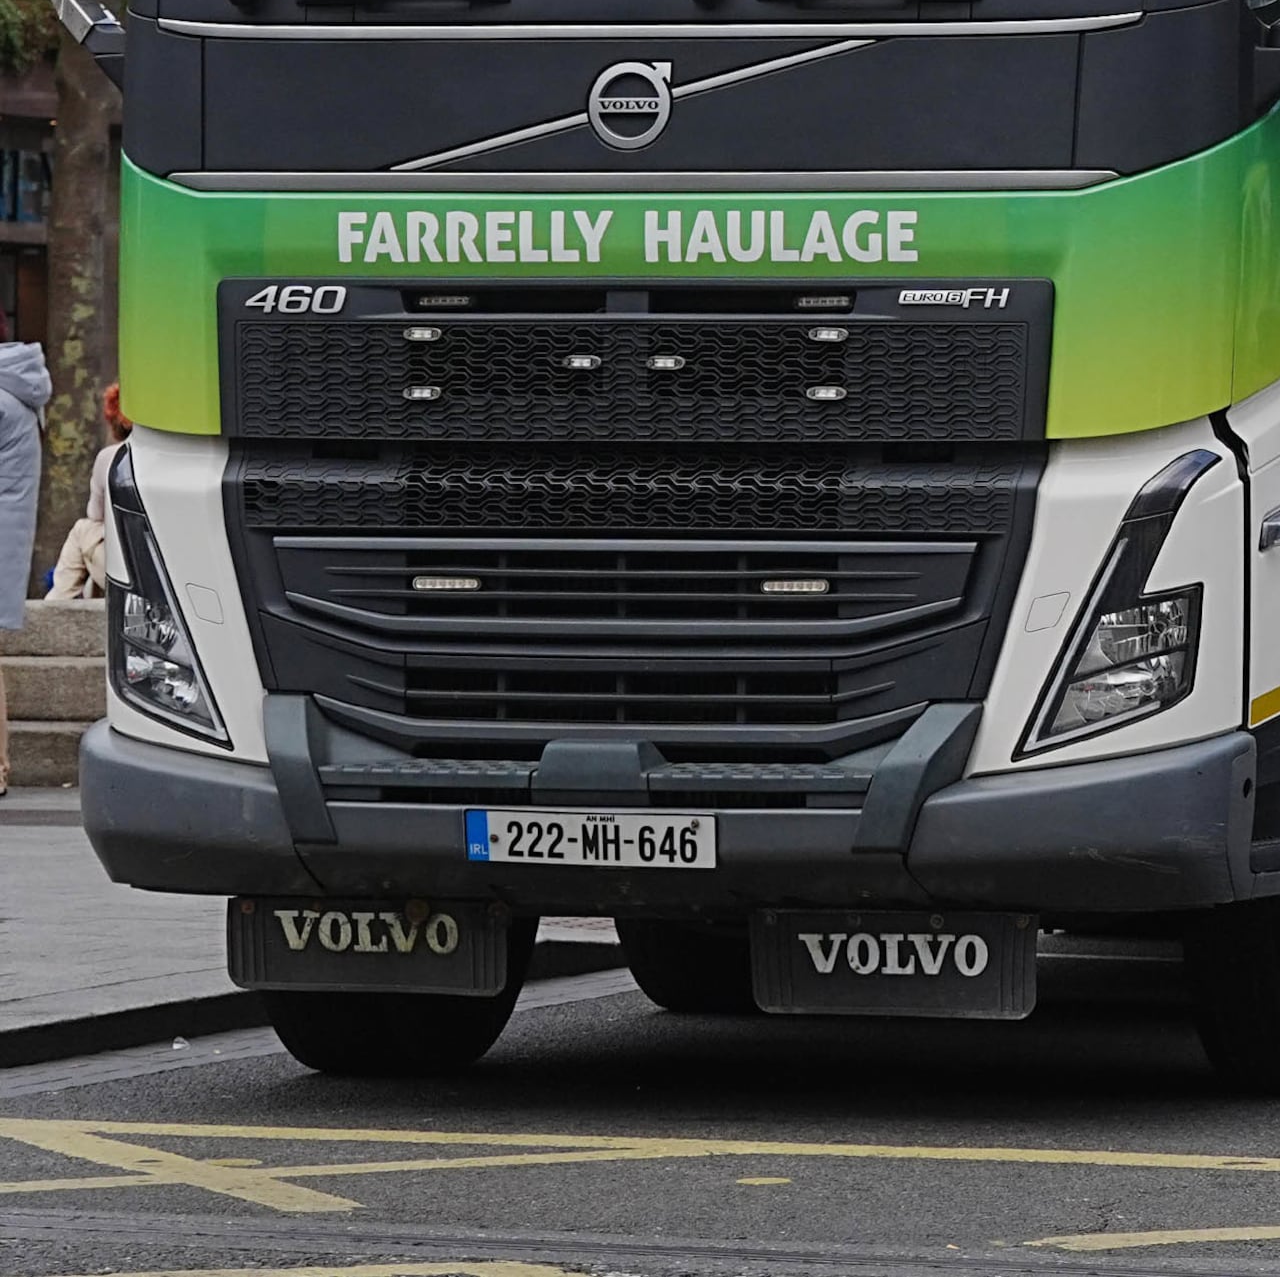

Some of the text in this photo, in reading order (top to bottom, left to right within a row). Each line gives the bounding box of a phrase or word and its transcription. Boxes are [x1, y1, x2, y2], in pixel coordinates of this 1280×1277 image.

[599, 100, 659, 110] VOLVO
[336, 210, 918, 264] FARRELLY HAULAGE
[244, 285, 346, 314] 460
[903, 292, 943, 302] EURO
[962, 288, 1010, 309] FH
[470, 843, 489, 855] IRL
[506, 820, 698, 864] 222-MH-646
[273, 910, 459, 955] VOLVO
[797, 932, 989, 977] VOLVO
